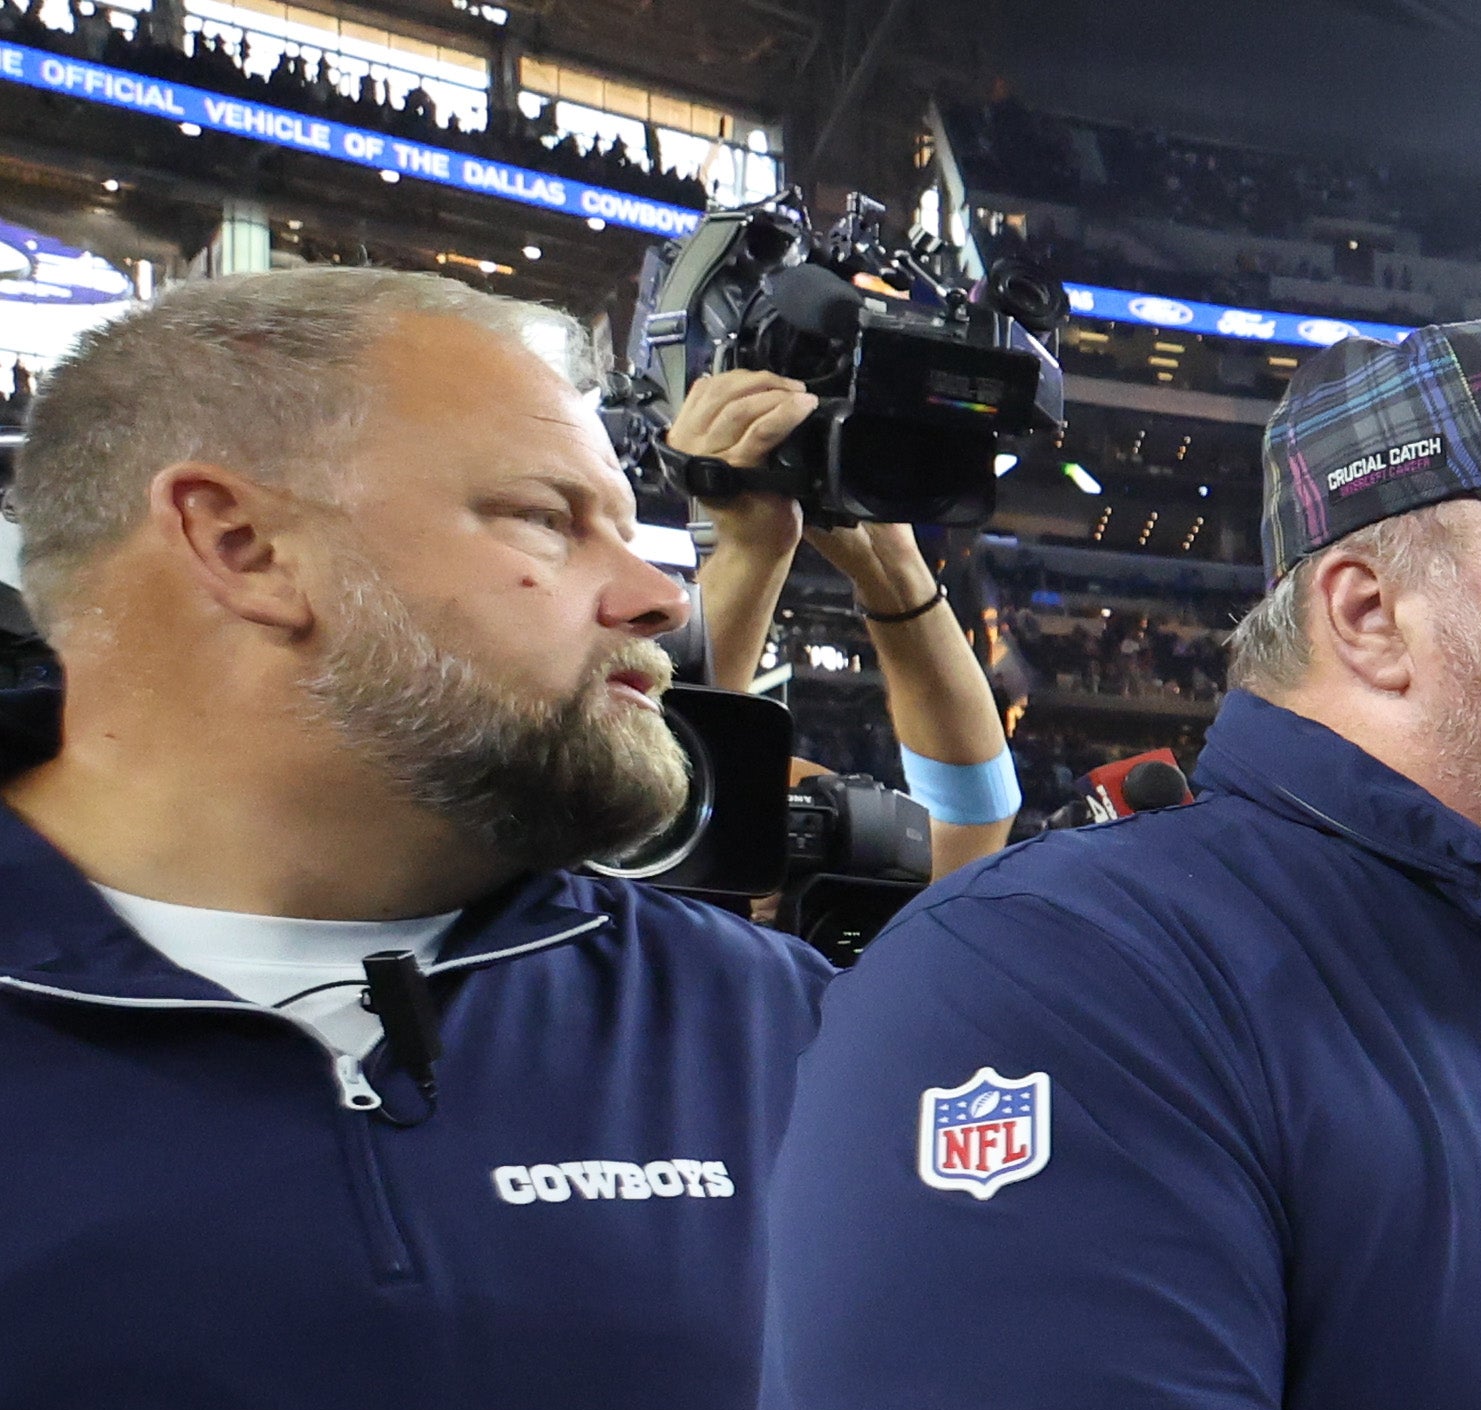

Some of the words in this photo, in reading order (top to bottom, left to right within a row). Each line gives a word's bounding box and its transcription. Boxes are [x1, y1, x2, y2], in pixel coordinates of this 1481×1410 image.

[42, 57, 186, 116] OFFICIAL
[204, 99, 331, 152] VEHICLE
[345, 131, 385, 161] OF
[394, 143, 450, 179] THE
[463, 157, 567, 206] DALLAS
[1327, 453, 1387, 491] CRUCIAL
[1389, 437, 1441, 466] CATCH
[942, 1120, 1028, 1172] NFL
[493, 1158, 734, 1205] COWBOYS
